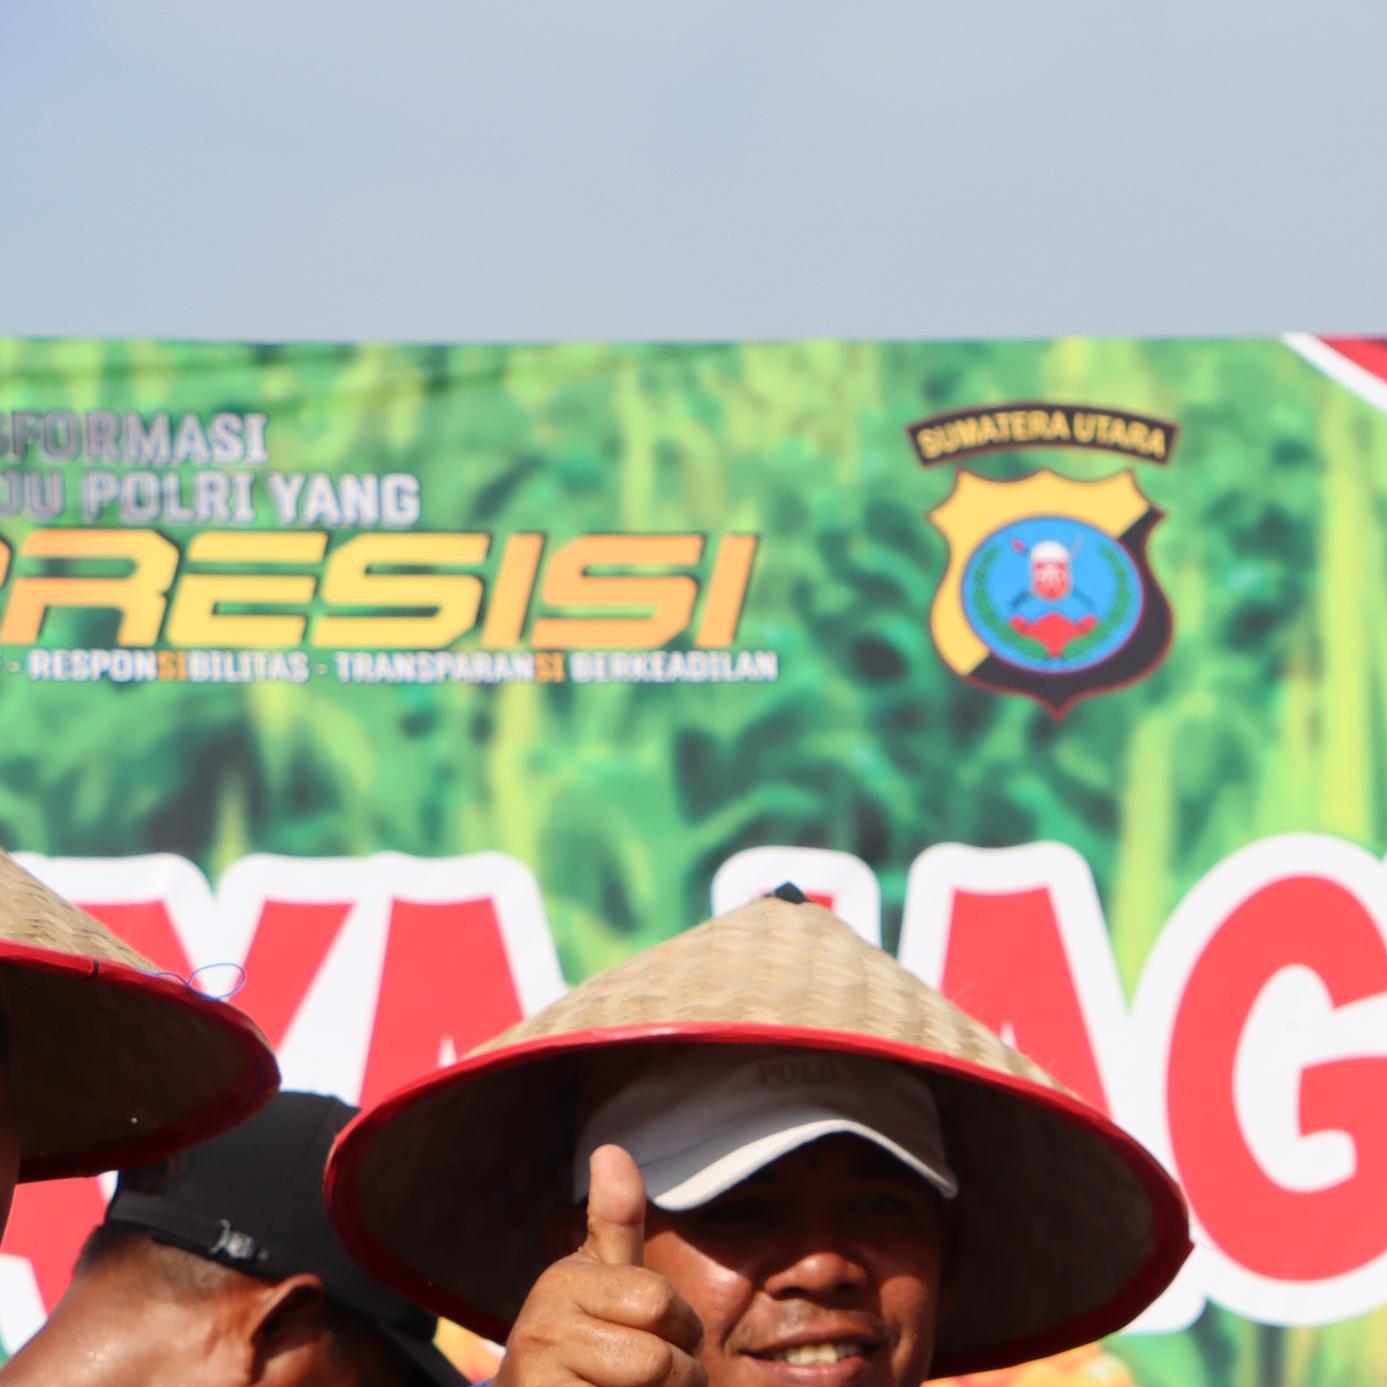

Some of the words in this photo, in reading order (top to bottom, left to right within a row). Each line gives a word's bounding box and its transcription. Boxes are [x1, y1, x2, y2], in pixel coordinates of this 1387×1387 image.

[917, 410, 1071, 459] SUMATERA
[1073, 411, 1166, 458] UTARA
[83, 471, 256, 524] POLRI
[267, 472, 422, 526] YANG
[0, 528, 758, 648] RESISI
[28, 650, 309, 683] RESPONSIBILITAS
[335, 650, 565, 683] TRANSPARANSI
[569, 651, 778, 683] BERKEADILAN
